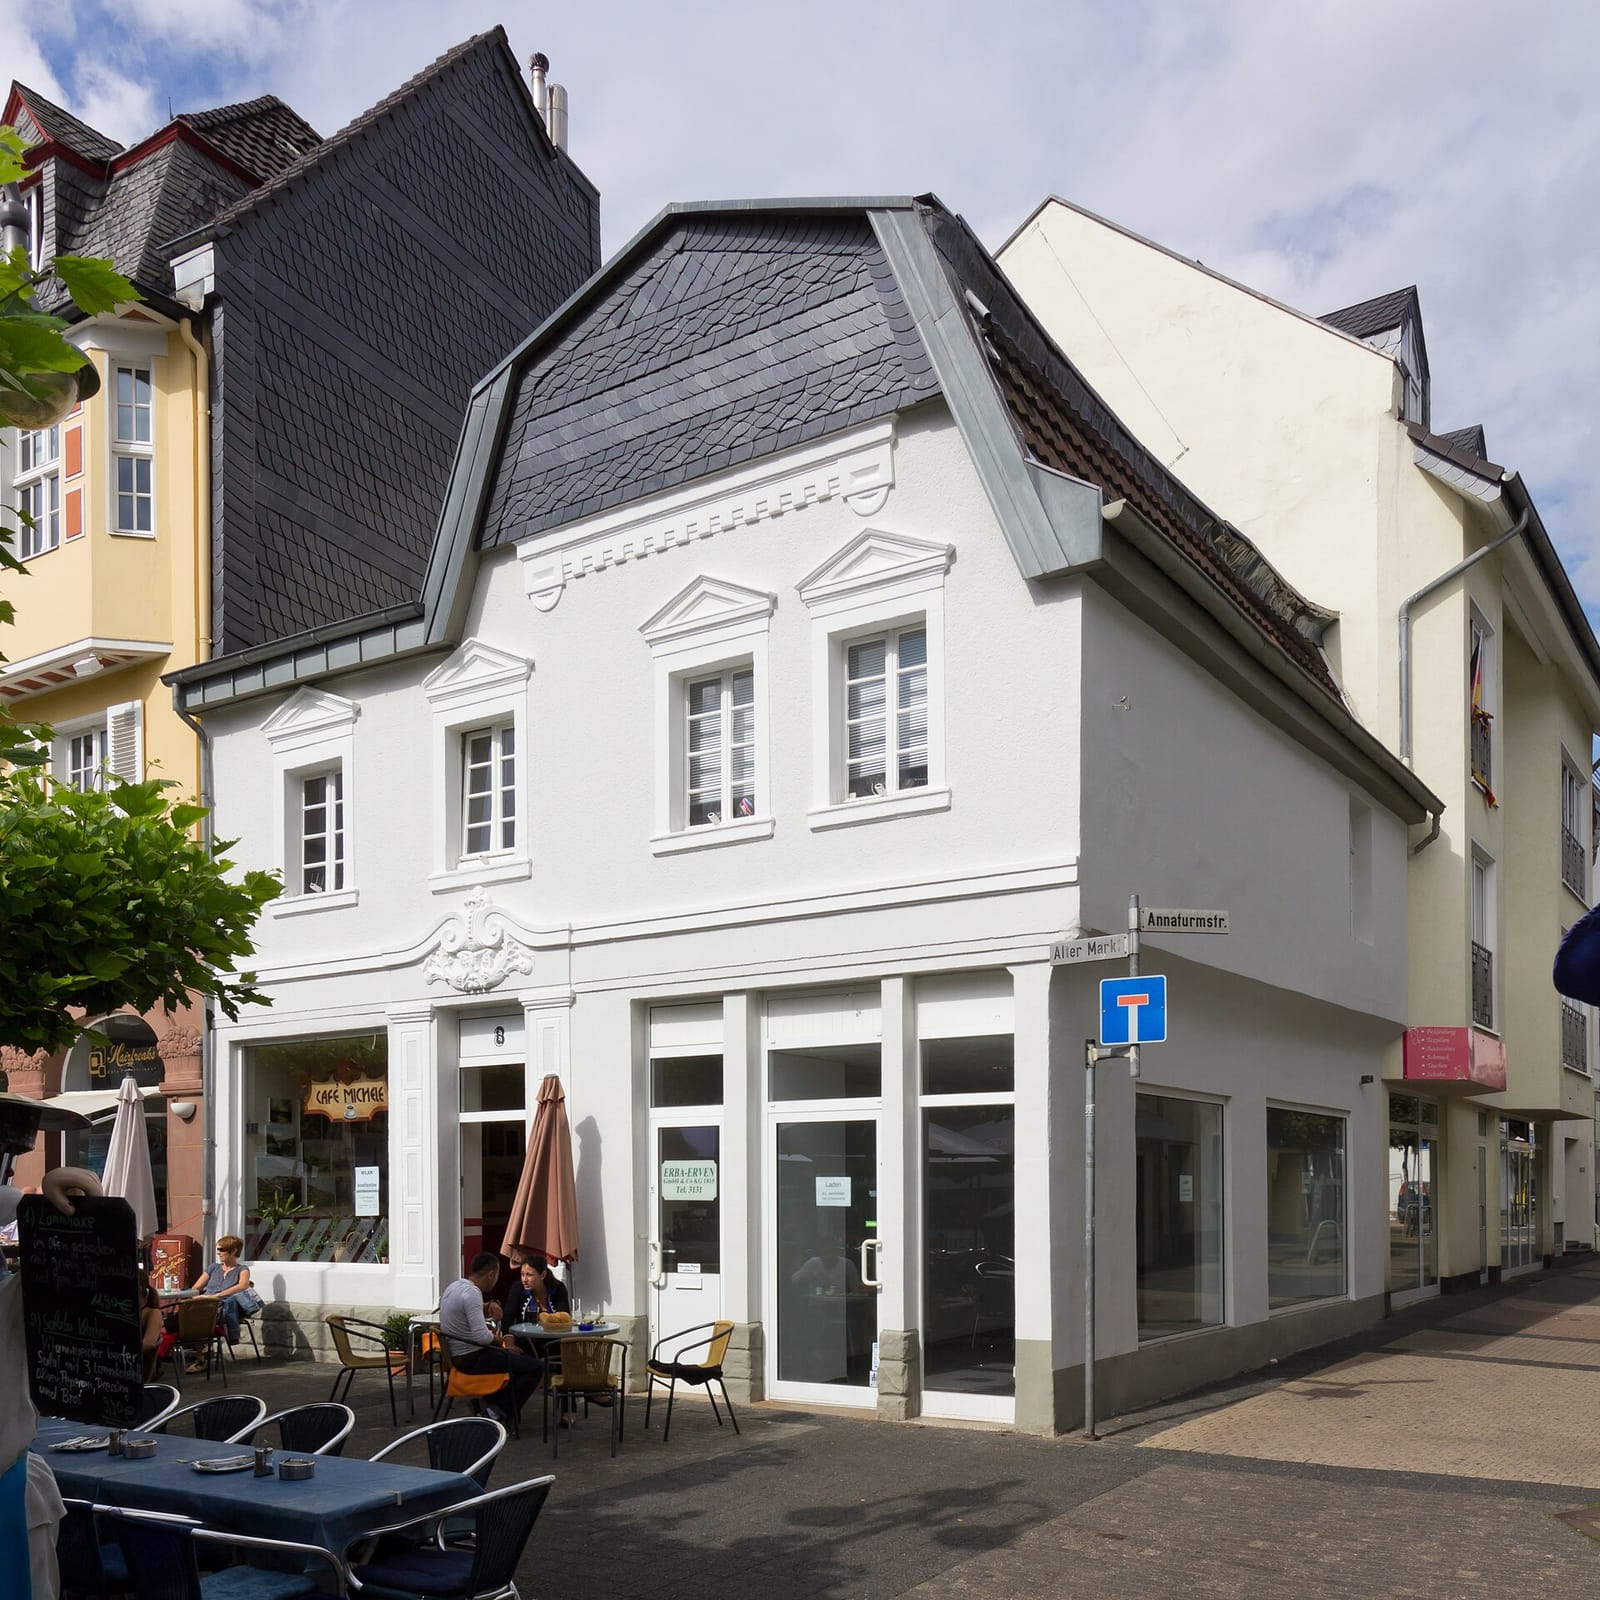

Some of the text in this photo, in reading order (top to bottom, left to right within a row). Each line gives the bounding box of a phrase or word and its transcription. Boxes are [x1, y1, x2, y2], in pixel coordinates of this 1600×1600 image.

[1147, 912, 1228, 929] Annaturmstr.
[495, 1026, 505, 1046] 8
[107, 1042, 156, 1067] Hairfreaks
[343, 1086, 384, 1104] MICHELE
[663, 1167, 715, 1178] ERBA-ERVEN
[688, 1186, 703, 1194] 3131
